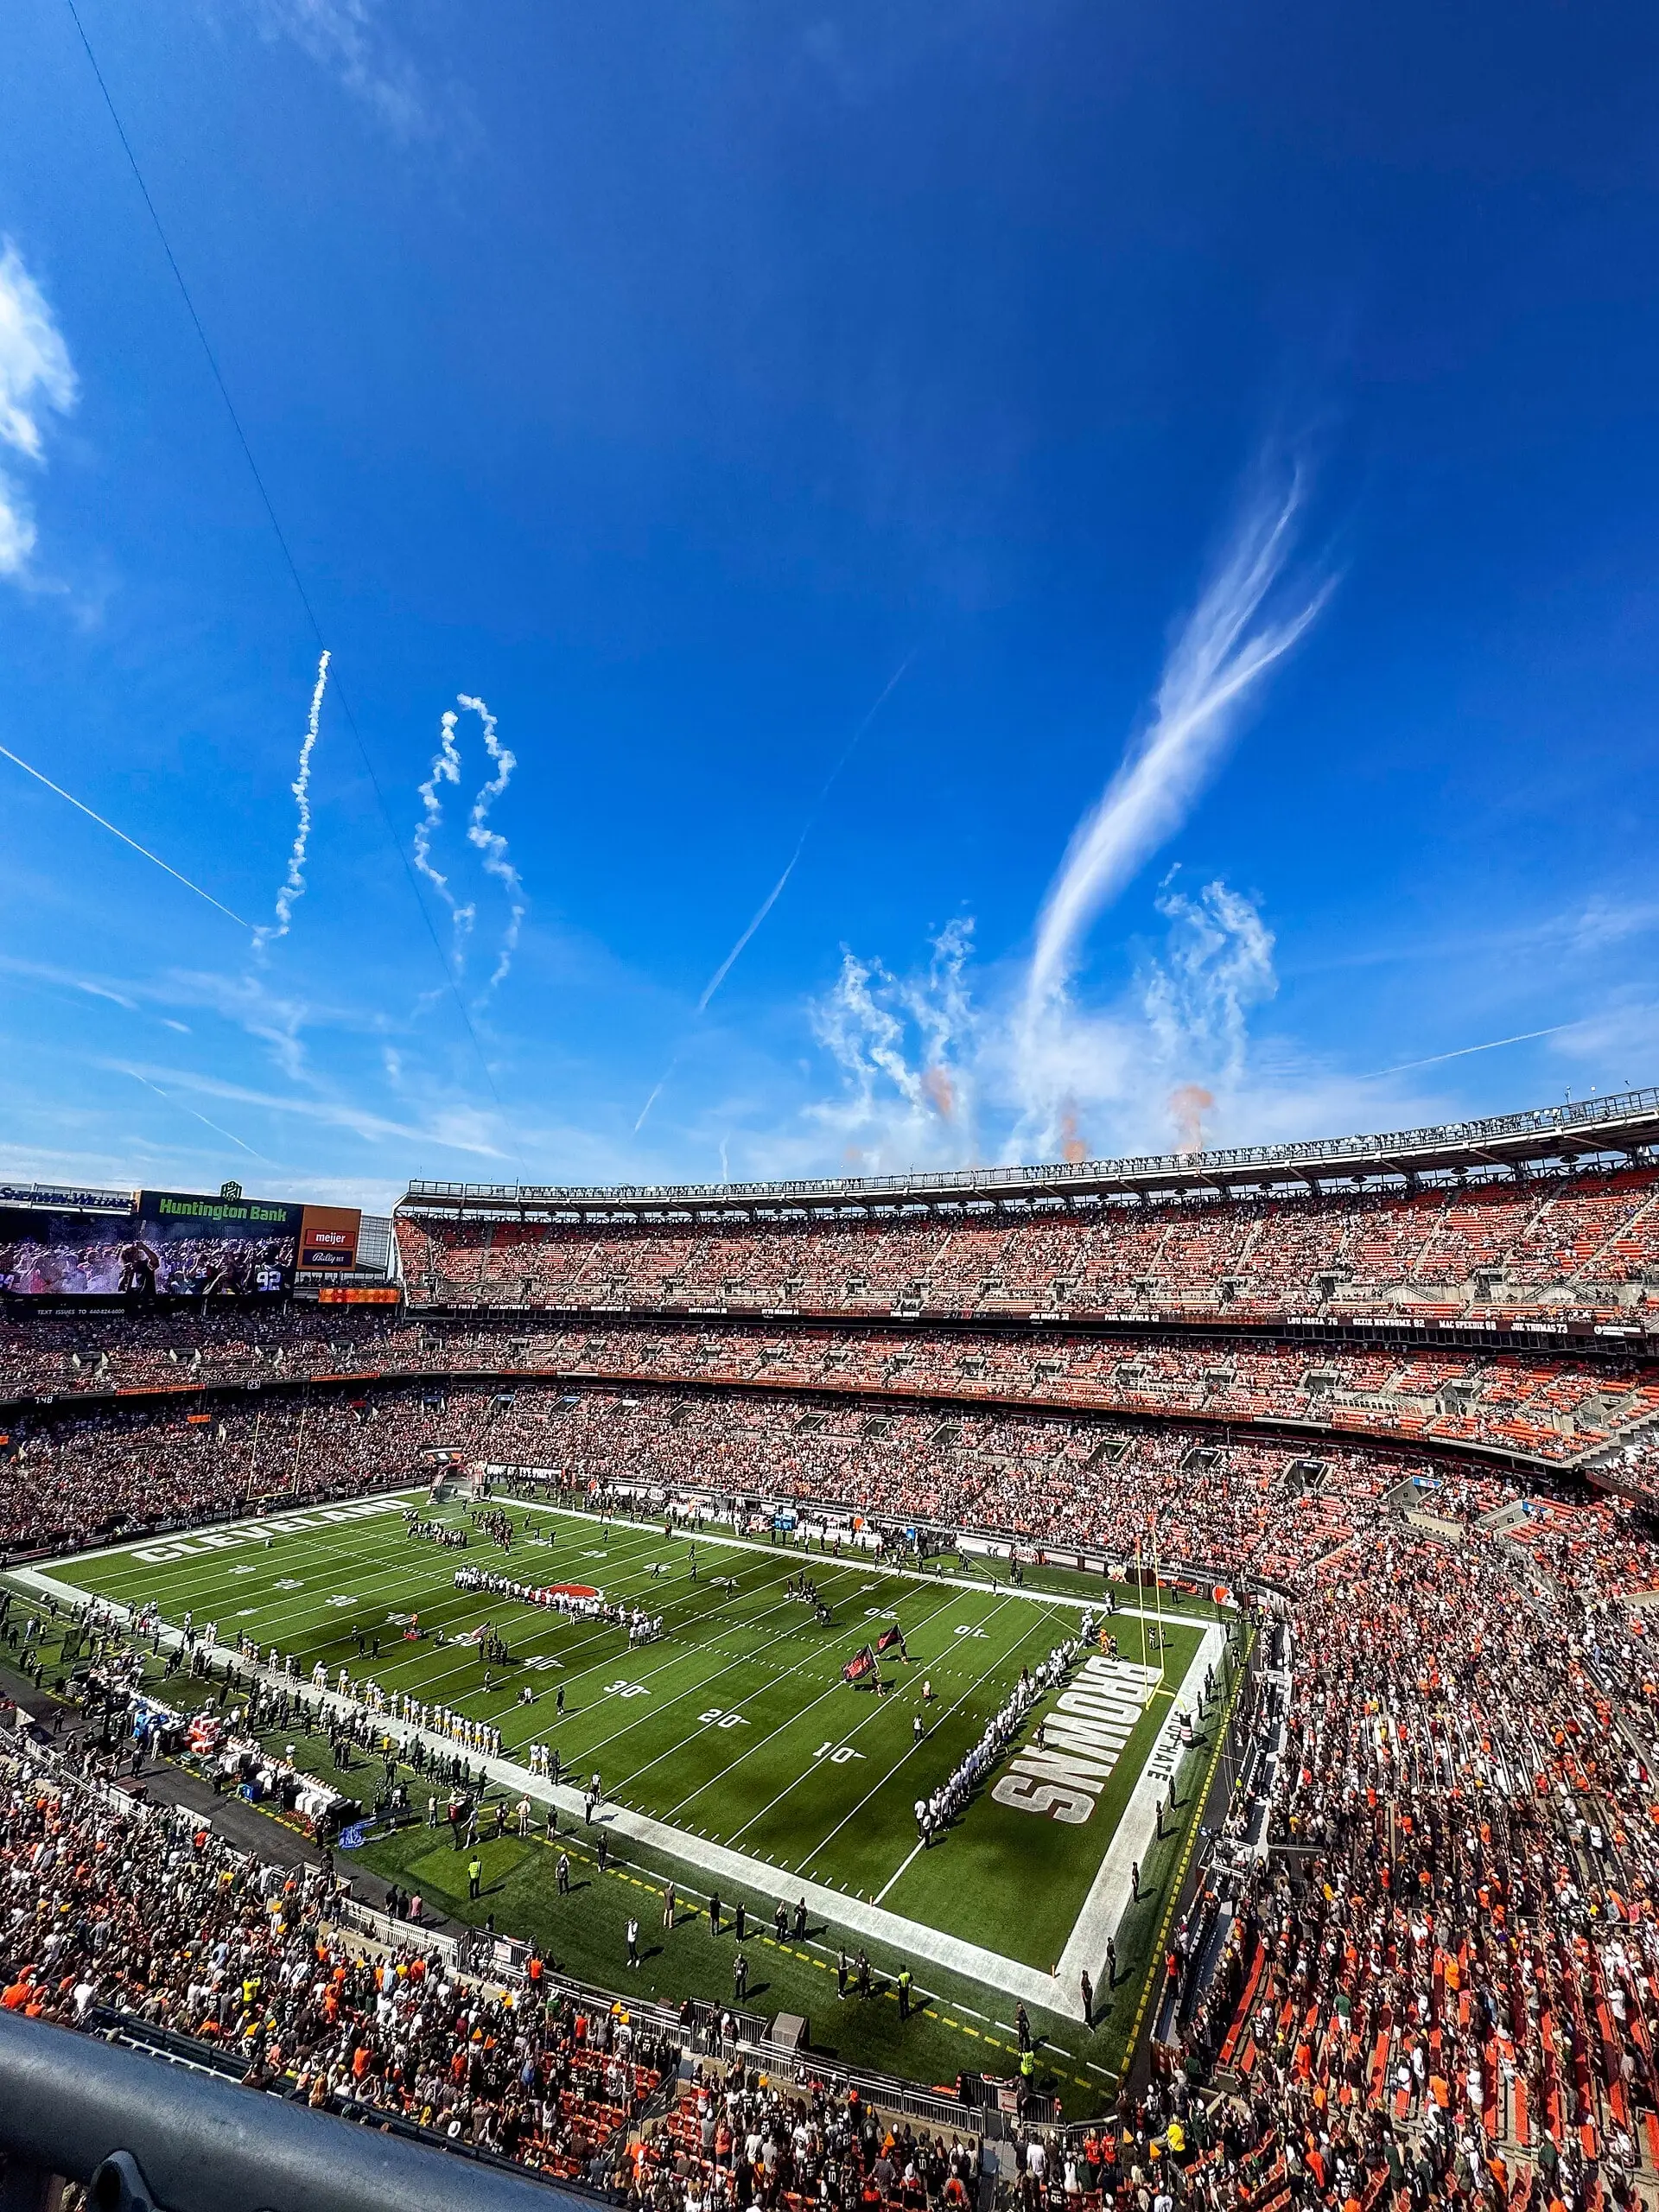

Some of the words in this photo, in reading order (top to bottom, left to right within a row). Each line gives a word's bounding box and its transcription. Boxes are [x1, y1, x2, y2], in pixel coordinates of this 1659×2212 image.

[159, 1198, 247, 1221] Huntington
[249, 1205, 287, 1222] Bank
[315, 1232, 346, 1245] meijer
[257, 1271, 282, 1292] 92
[1374, 1319, 1412, 1327] NEWSOME
[1439, 1320, 1454, 1329] MAC
[1556, 1325, 1568, 1333] 73
[130, 1499, 415, 1563] CLEVELAND
[603, 1680, 644, 1698] 30
[696, 1708, 742, 1729] 20
[990, 1655, 1165, 1824] BROWNS
[811, 1741, 856, 1764] 10
[1147, 1743, 1178, 1783] HATE
[761, 2124, 770, 2135] 24
[918, 2158, 927, 2171] 10
[828, 2171, 836, 2183] 10
